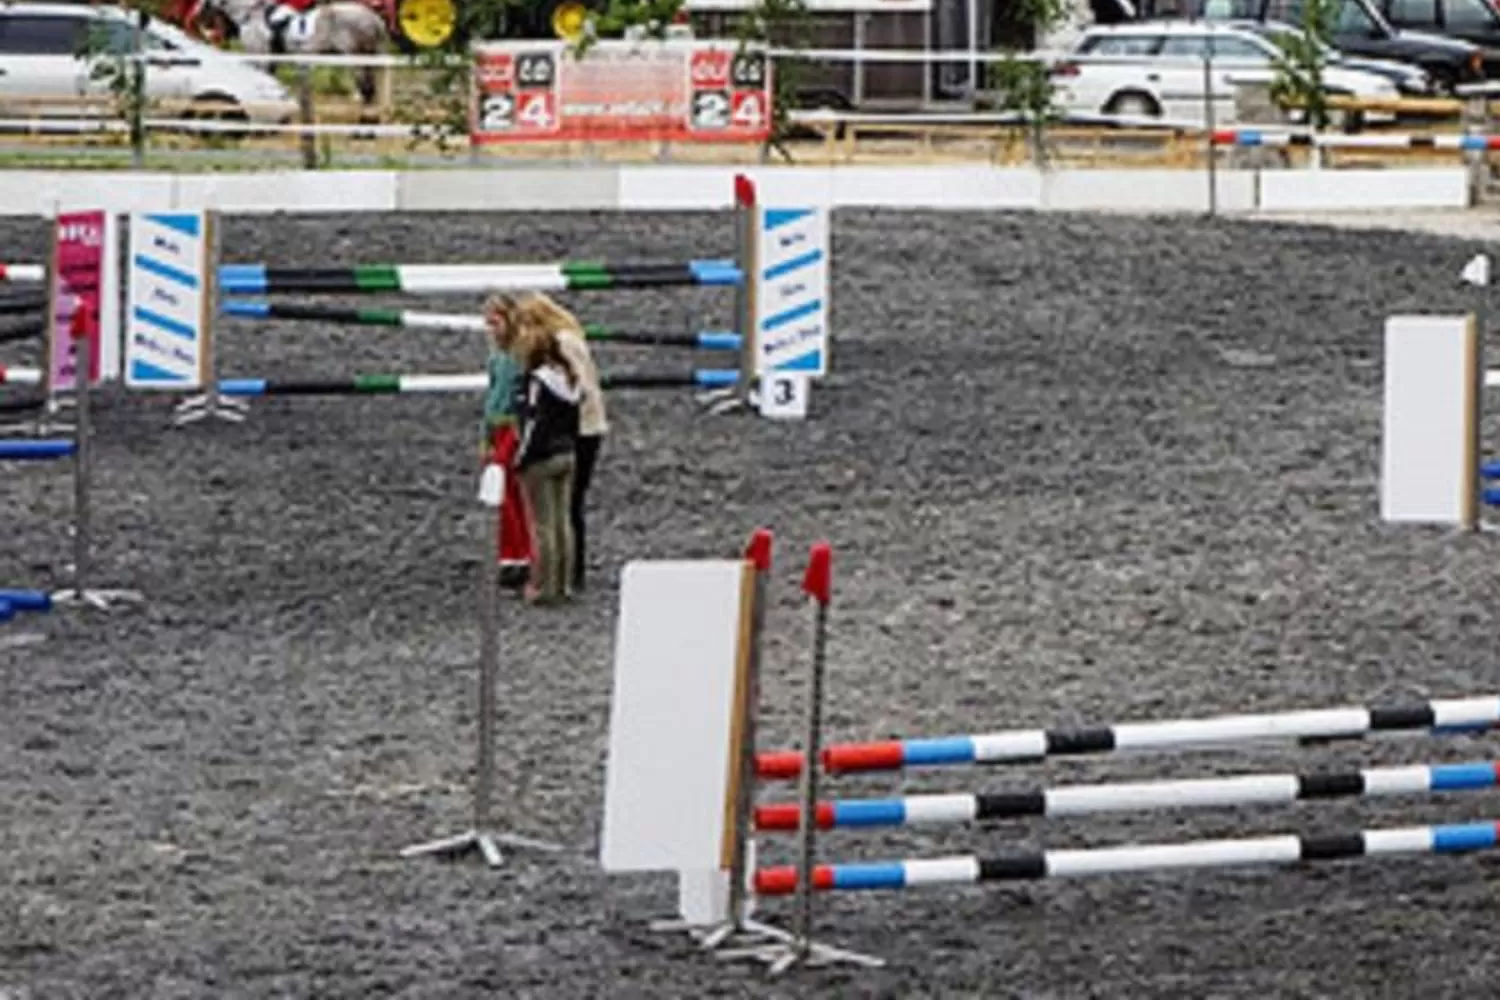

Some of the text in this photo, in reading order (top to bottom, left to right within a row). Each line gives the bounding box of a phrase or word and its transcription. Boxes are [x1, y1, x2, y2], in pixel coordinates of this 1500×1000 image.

[484, 95, 553, 130] 24
[695, 94, 765, 129] 24
[773, 378, 795, 405] 3
